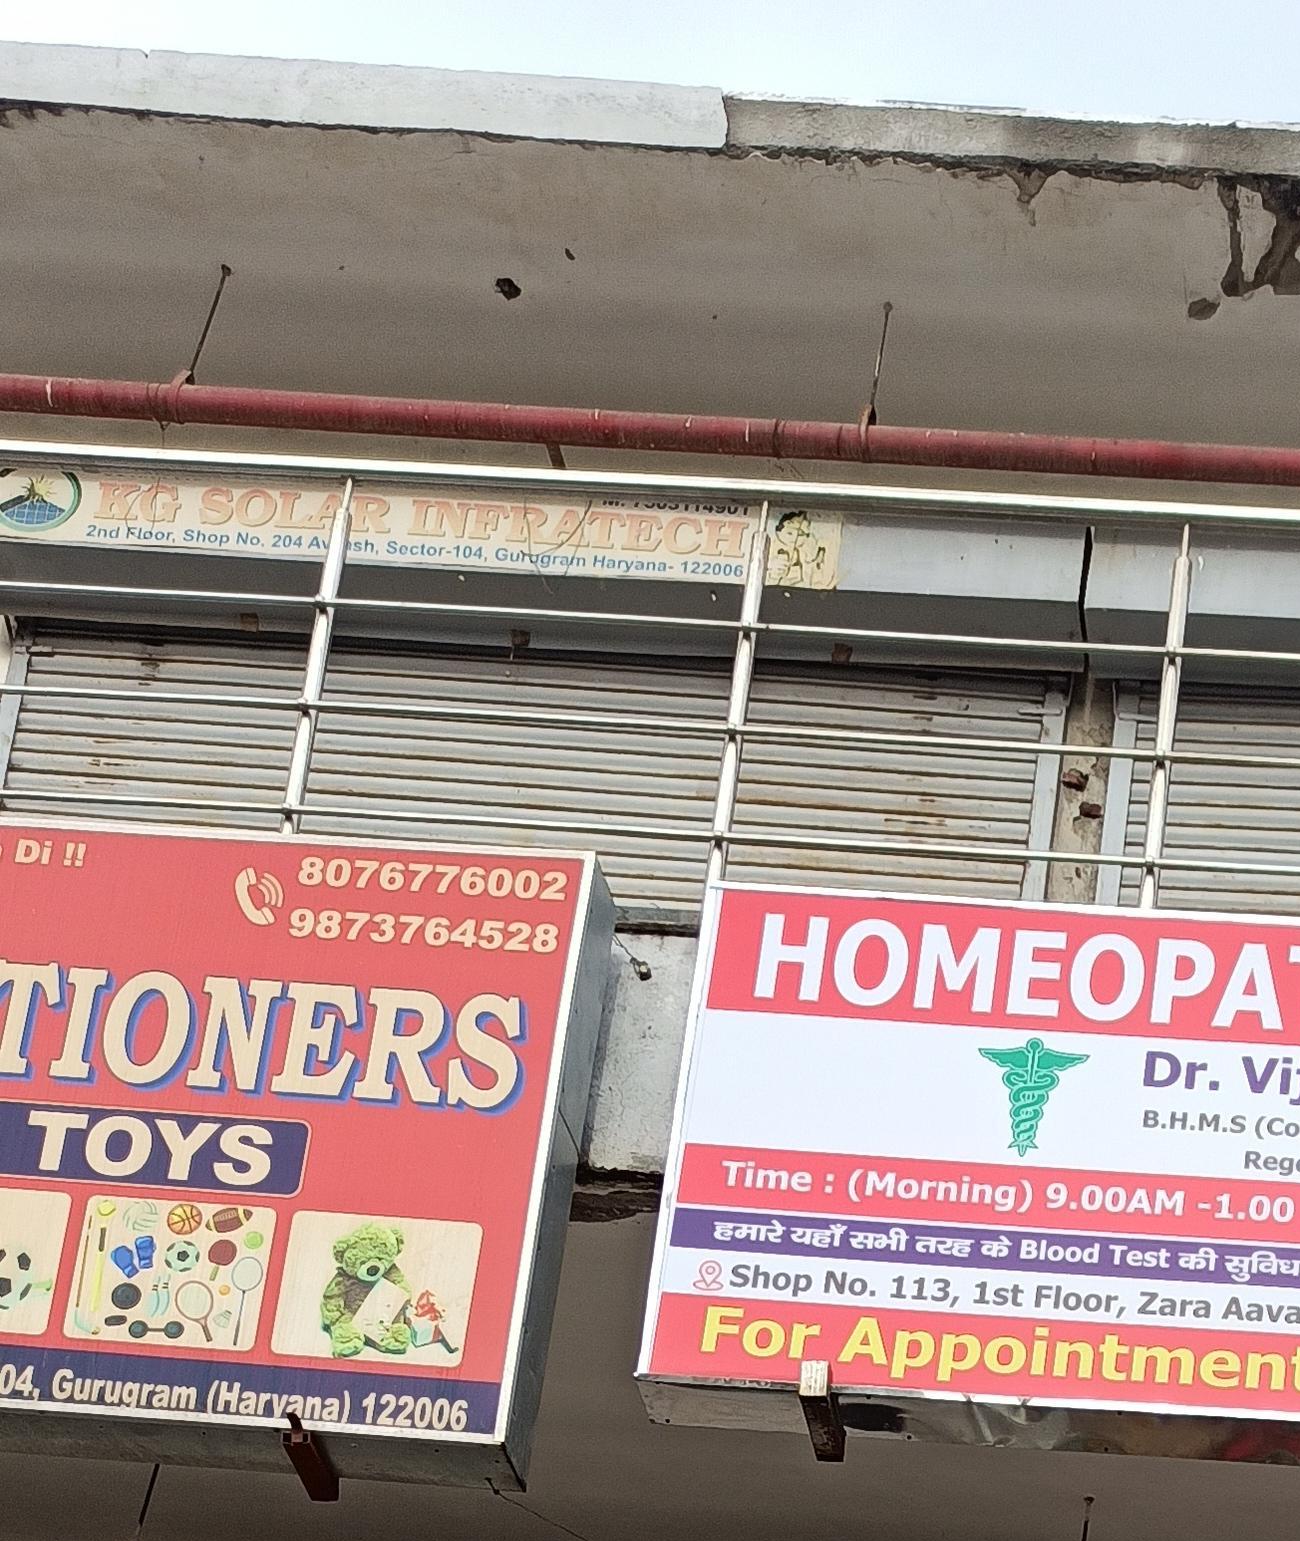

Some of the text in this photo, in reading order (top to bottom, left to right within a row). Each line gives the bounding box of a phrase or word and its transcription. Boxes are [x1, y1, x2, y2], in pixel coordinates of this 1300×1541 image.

[92, 478, 751, 560] KG SOLAR INFRATECH
[85, 523, 745, 578] 2nd Floor, Shop No. 204 122006
[14, 838, 53, 865] Di
[298, 856, 569, 902] 8076776002
[288, 906, 560, 955] 9873764528
[1142, 1049, 1221, 1093] Dr.
[26, 1110, 275, 1187] TOYS
[1142, 1108, 1247, 1136] B.H.M.S
[721, 1159, 813, 1194] Time
[846, 1166, 1034, 1215] (Morning)
[1044, 1180, 1185, 1217] 9.00AM
[711, 1219, 787, 1246] हमारे
[789, 1221, 846, 1251] यहाँ
[848, 1224, 908, 1254] सभी
[914, 1231, 971, 1260] तरह
[980, 1230, 1011, 1259] के
[1018, 1236, 1100, 1267] Blood
[1107, 1241, 1171, 1271] Test
[1177, 1242, 1217, 1274] की
[728, 1264, 814, 1299] Shop
[822, 1269, 877, 1298] No.
[889, 1275, 960, 1309] 113,
[972, 1279, 1025, 1309] 1st
[1033, 1284, 1126, 1318] Floor,
[1136, 1290, 1213, 1320] Zara
[700, 1303, 822, 1360] For
[361, 1390, 469, 1432] 122006
